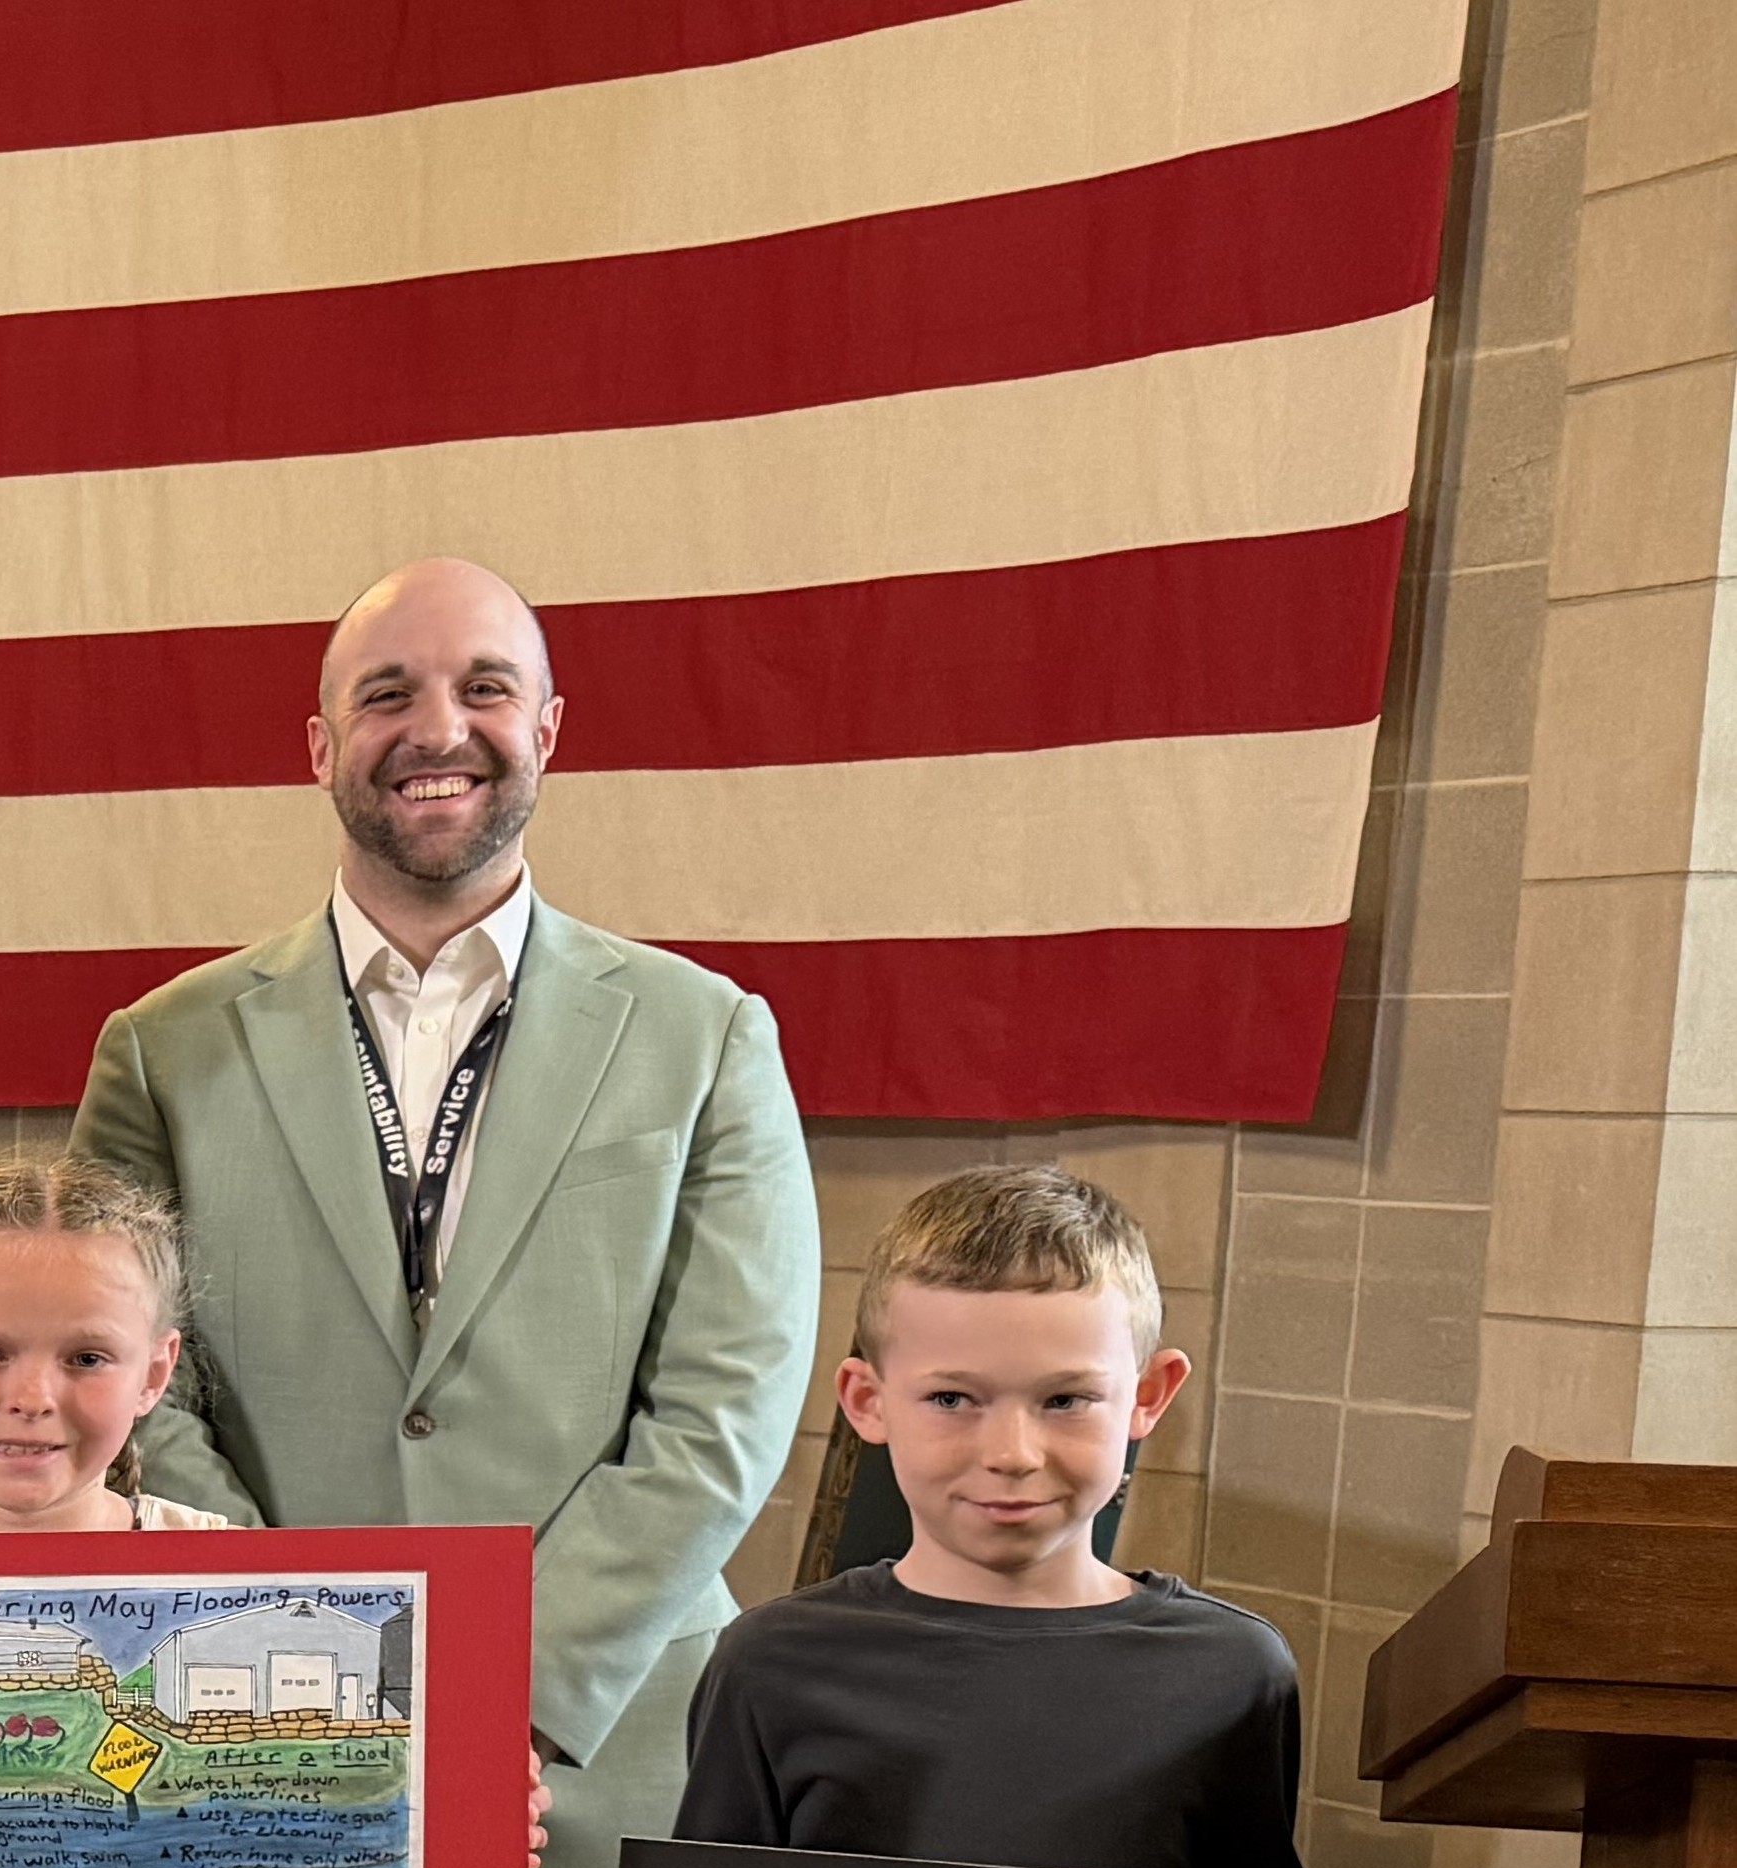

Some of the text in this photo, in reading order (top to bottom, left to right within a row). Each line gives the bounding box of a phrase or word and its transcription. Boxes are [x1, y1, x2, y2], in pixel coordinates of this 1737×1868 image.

[426, 1067, 475, 1175] Service
[89, 1593, 156, 1630] May
[172, 1588, 291, 1615] Flooding
[316, 1588, 405, 1608] Powers
[174, 1771, 340, 1791] Watch for down
[67, 1788, 114, 1810] flood
[208, 1787, 322, 1804] powerlines
[84, 1816, 135, 1836] higher
